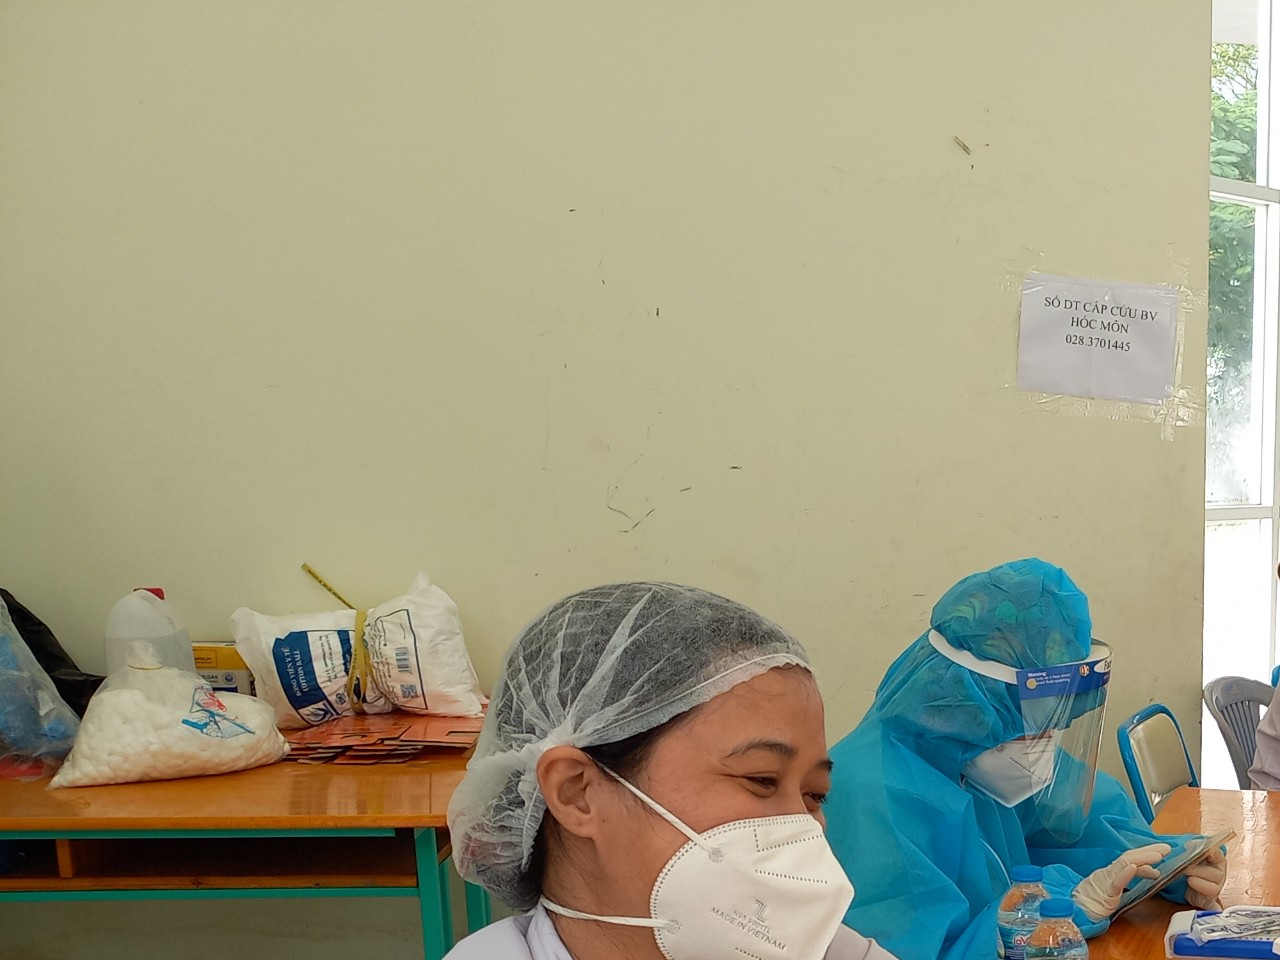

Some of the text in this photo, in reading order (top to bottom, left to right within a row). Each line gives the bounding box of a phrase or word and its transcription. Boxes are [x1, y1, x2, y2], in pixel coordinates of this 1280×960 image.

[1064, 300, 1081, 311] DT
[1140, 310, 1159, 321] BV
[1070, 315, 1130, 334] HÓC MÔN
[1065, 334, 1131, 352] 028.3701445
[712, 906, 787, 952] MADE IN VIETNAM
[1013, 937, 1029, 946] laV
